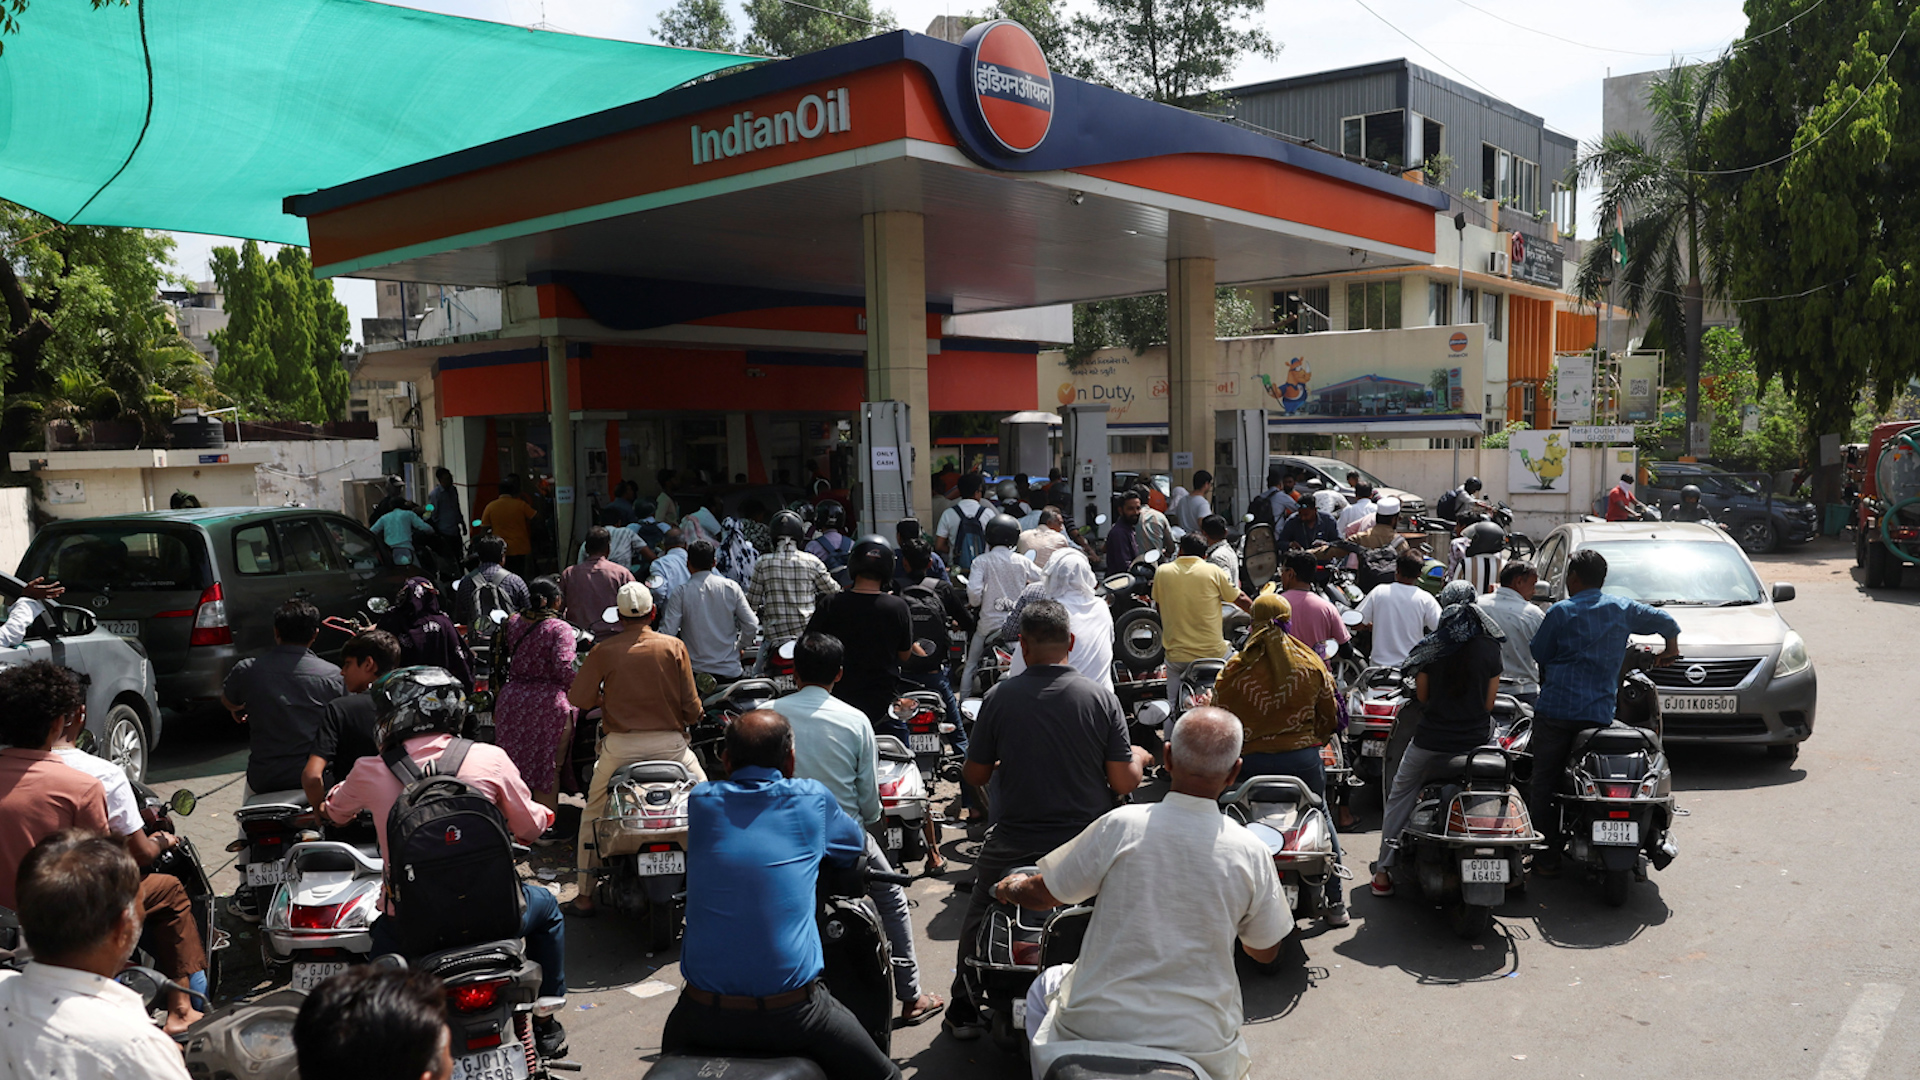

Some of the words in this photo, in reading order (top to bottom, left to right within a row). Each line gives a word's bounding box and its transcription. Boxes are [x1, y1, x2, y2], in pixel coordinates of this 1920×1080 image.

[978, 64, 1051, 105] इंडियनऑयल
[691, 88, 851, 165] IndianOil
[1092, 384, 1135, 402] Duty,
[1601, 832, 1630, 842] J2914
[1472, 870, 1502, 881] A6405
